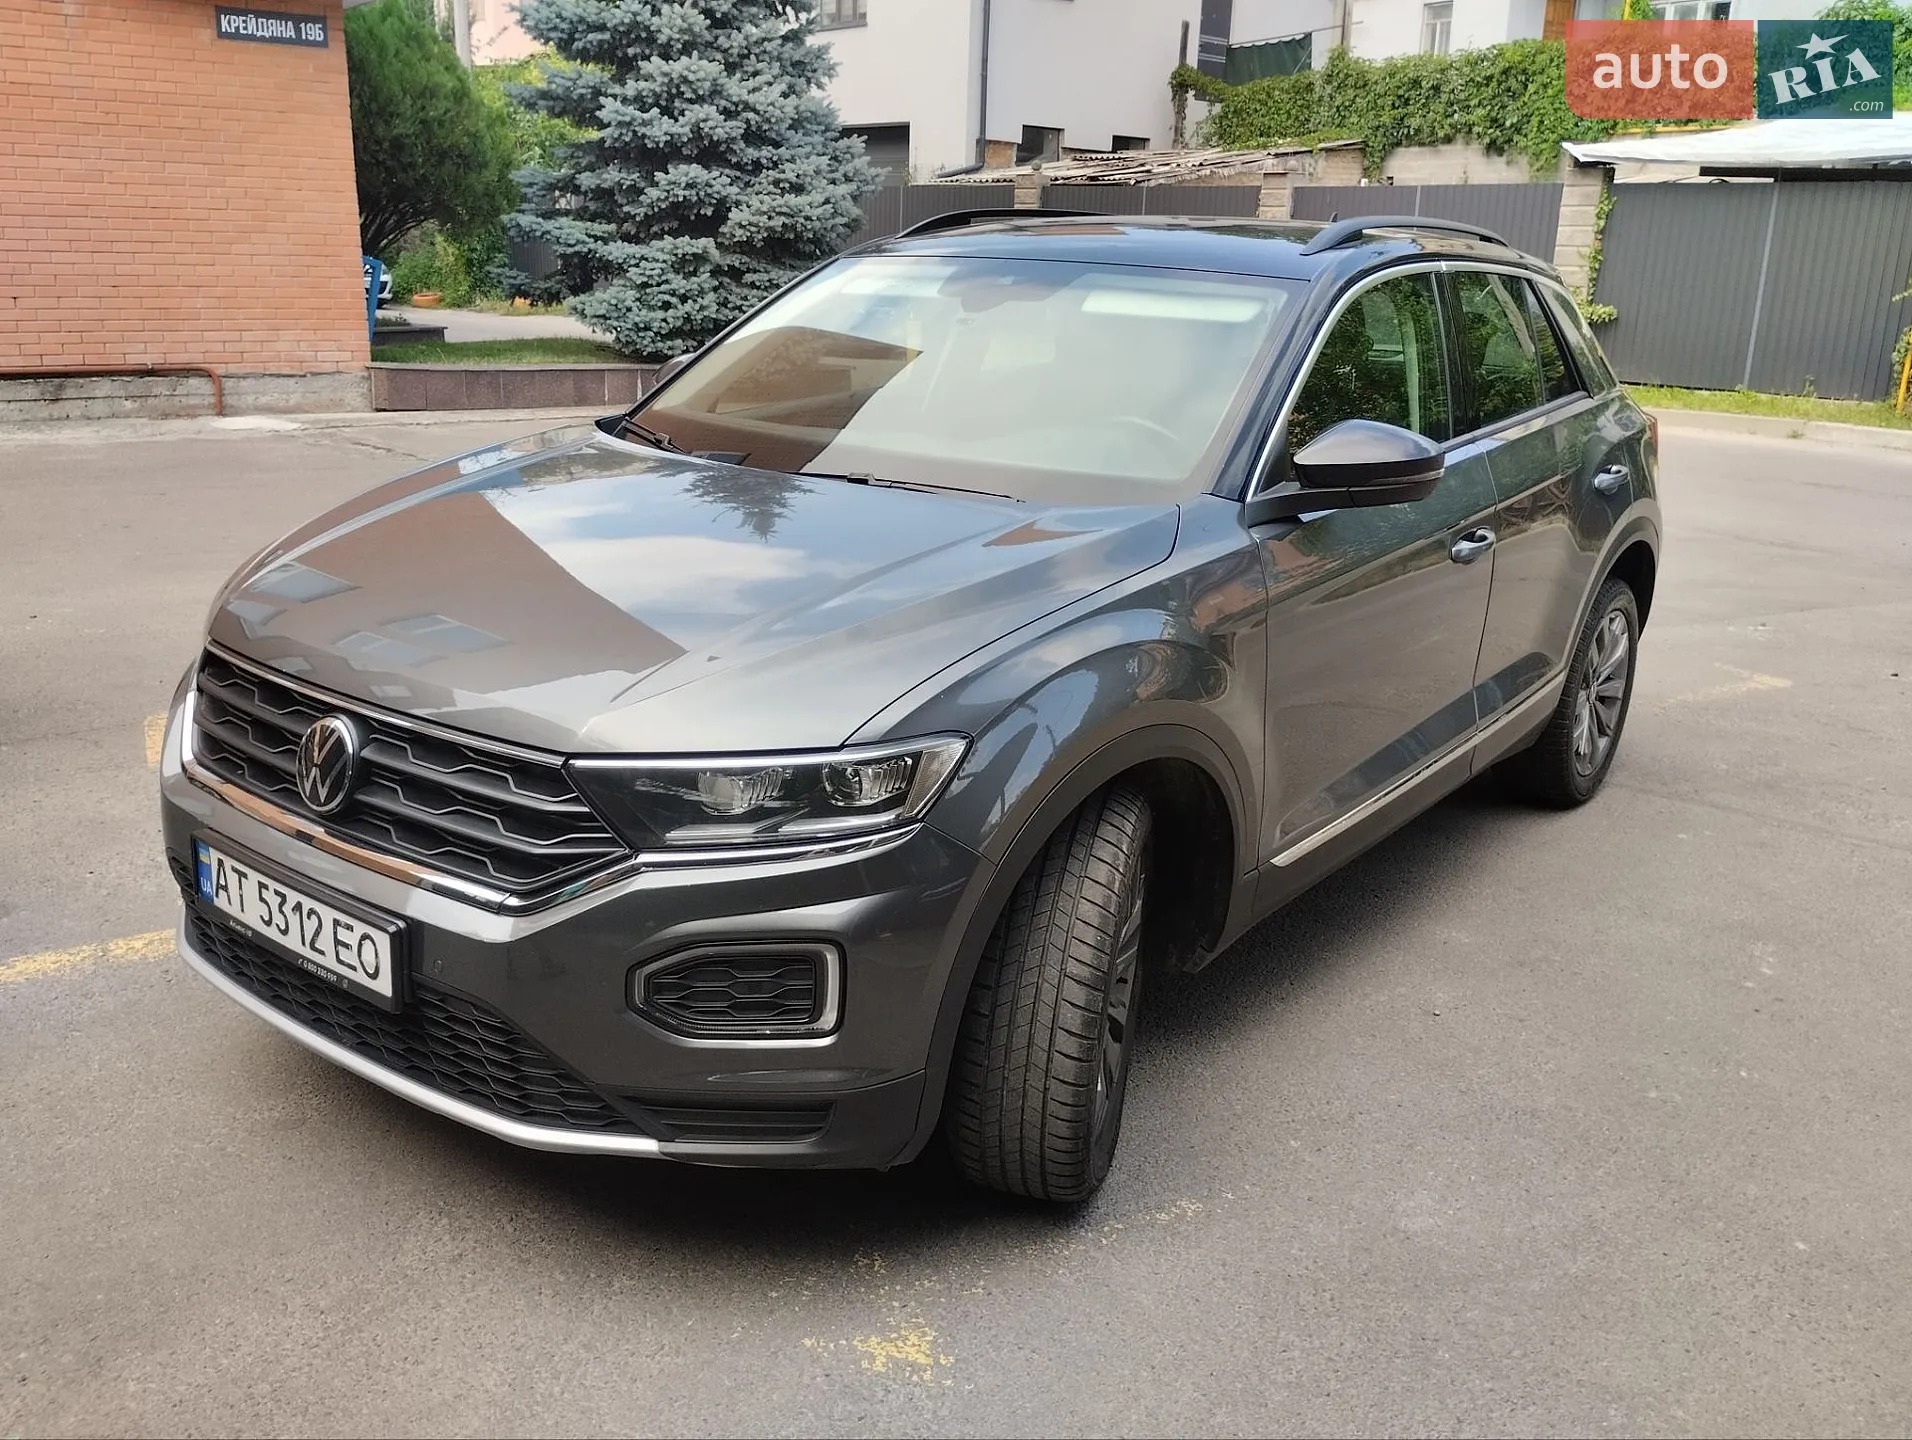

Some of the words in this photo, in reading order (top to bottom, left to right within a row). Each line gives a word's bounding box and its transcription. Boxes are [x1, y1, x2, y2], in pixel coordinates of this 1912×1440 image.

[220, 14, 296, 38] КРЕЙДЯНА
[299, 22, 324, 41] 19Б
[302, 720, 348, 803] VW
[200, 876, 213, 894] UA
[214, 857, 248, 913] AT
[257, 880, 326, 957] 5312
[332, 917, 380, 980] EO
